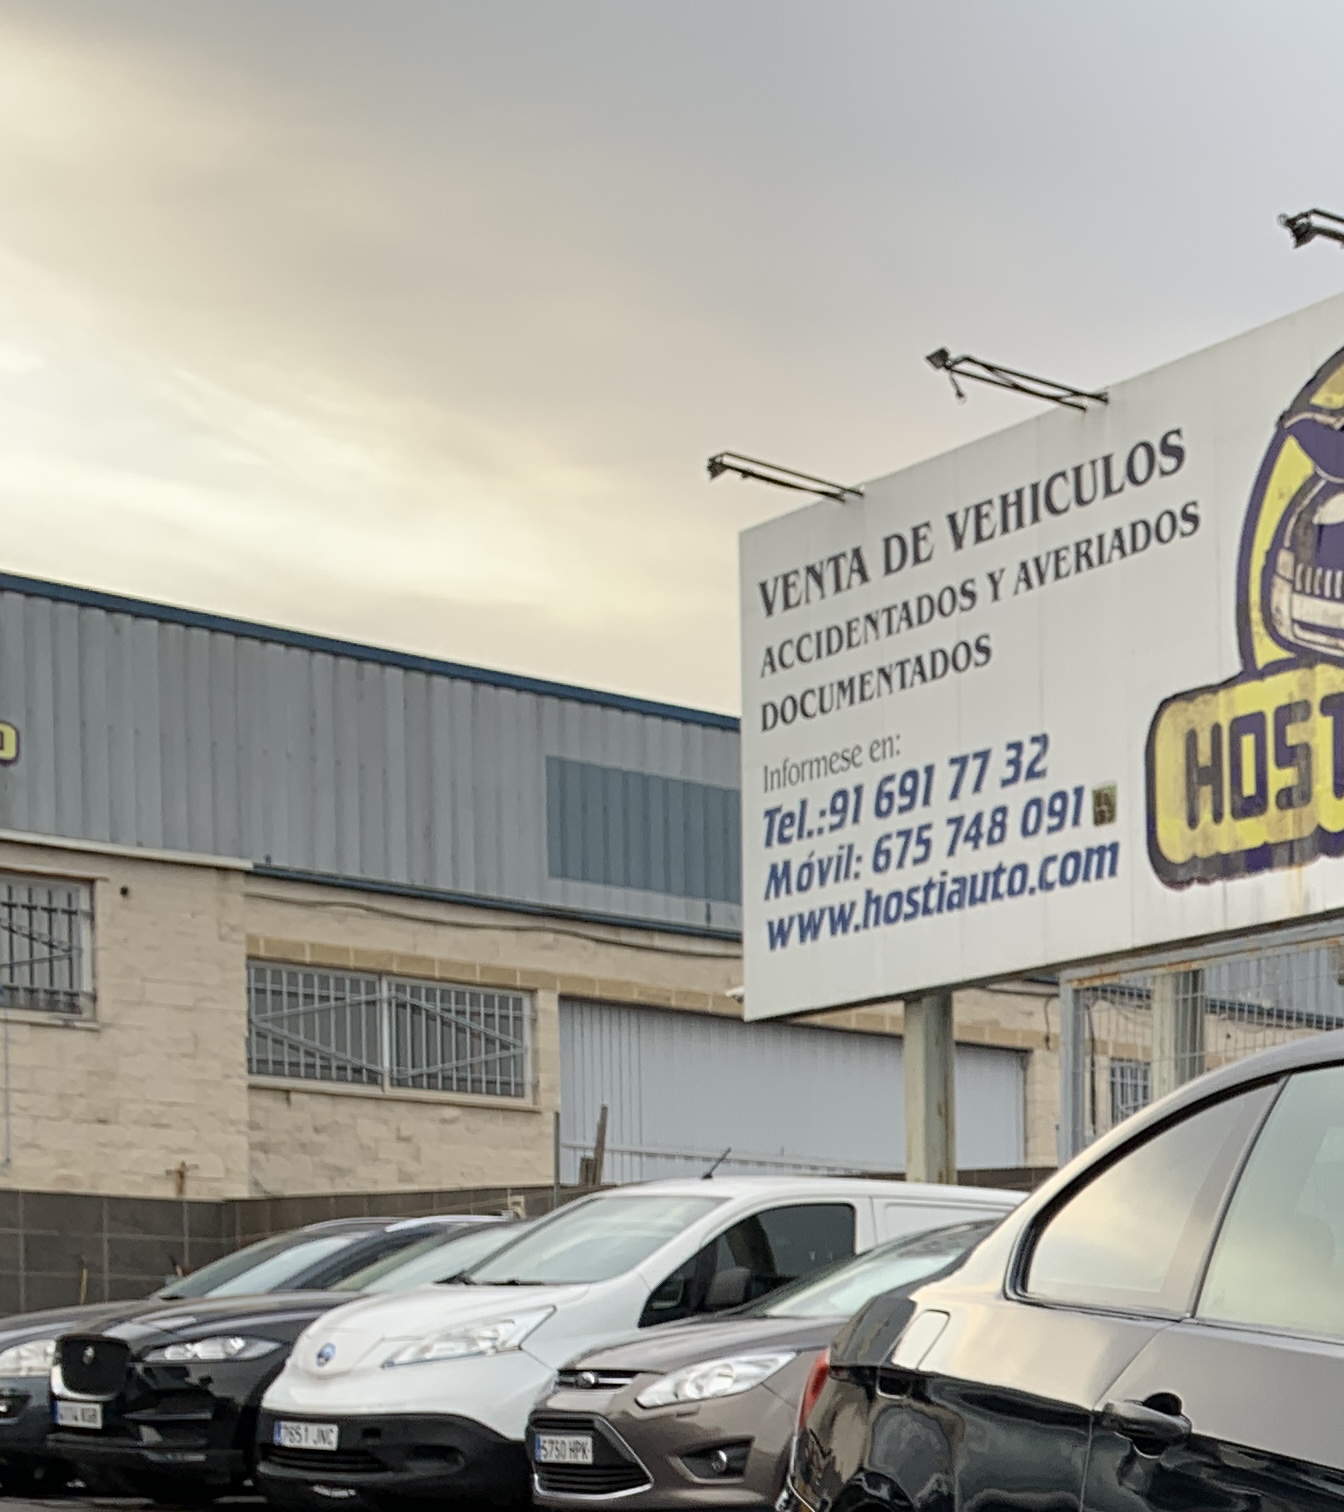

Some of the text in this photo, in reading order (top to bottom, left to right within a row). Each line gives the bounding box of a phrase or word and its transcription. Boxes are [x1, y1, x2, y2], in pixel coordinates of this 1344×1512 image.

[757, 427, 1187, 618] VENTA DE VEHICULOS
[760, 501, 1202, 679] ACCIDENTADOS Y AVERIADOS
[760, 633, 993, 732] DOCUMENTADOS
[868, 733, 901, 764] en:
[873, 765, 934, 816] 691
[947, 749, 992, 801] 77
[1000, 733, 1050, 788] 32
[763, 786, 1085, 901] Móvil: 675 748 091
[766, 841, 1120, 951] www.hostiauto.com
